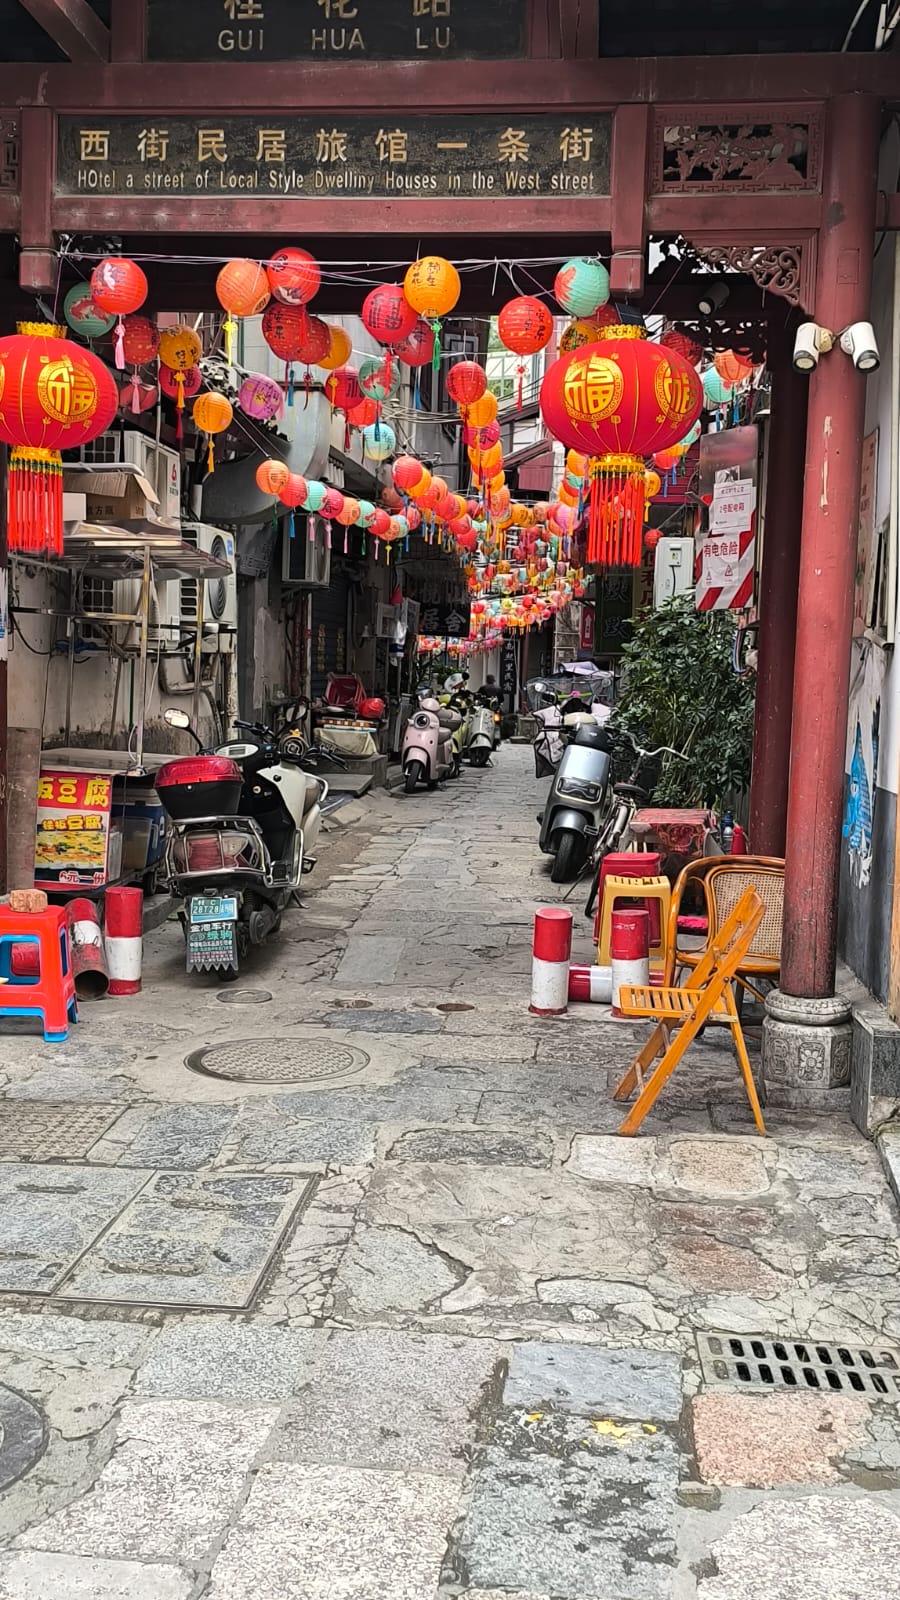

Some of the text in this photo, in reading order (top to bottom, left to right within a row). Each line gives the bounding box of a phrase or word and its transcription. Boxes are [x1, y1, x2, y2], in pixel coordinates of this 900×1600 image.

[217, 26, 450, 51] GUI HUA LU
[79, 128, 594, 163] 西街民居旅馆一条街
[126, 173, 134, 188] a
[144, 171, 184, 188] street
[195, 170, 209, 188] of
[220, 170, 258, 188] Local
[269, 169, 304, 193] Style
[385, 171, 437, 190] Houses
[449, 171, 461, 189] in
[472, 171, 494, 189] the
[505, 171, 541, 190] West
[550, 171, 594, 190] street
[46, 360, 96, 416] 福
[563, 353, 616, 414] 福
[703, 541, 738, 558] 有电危险
